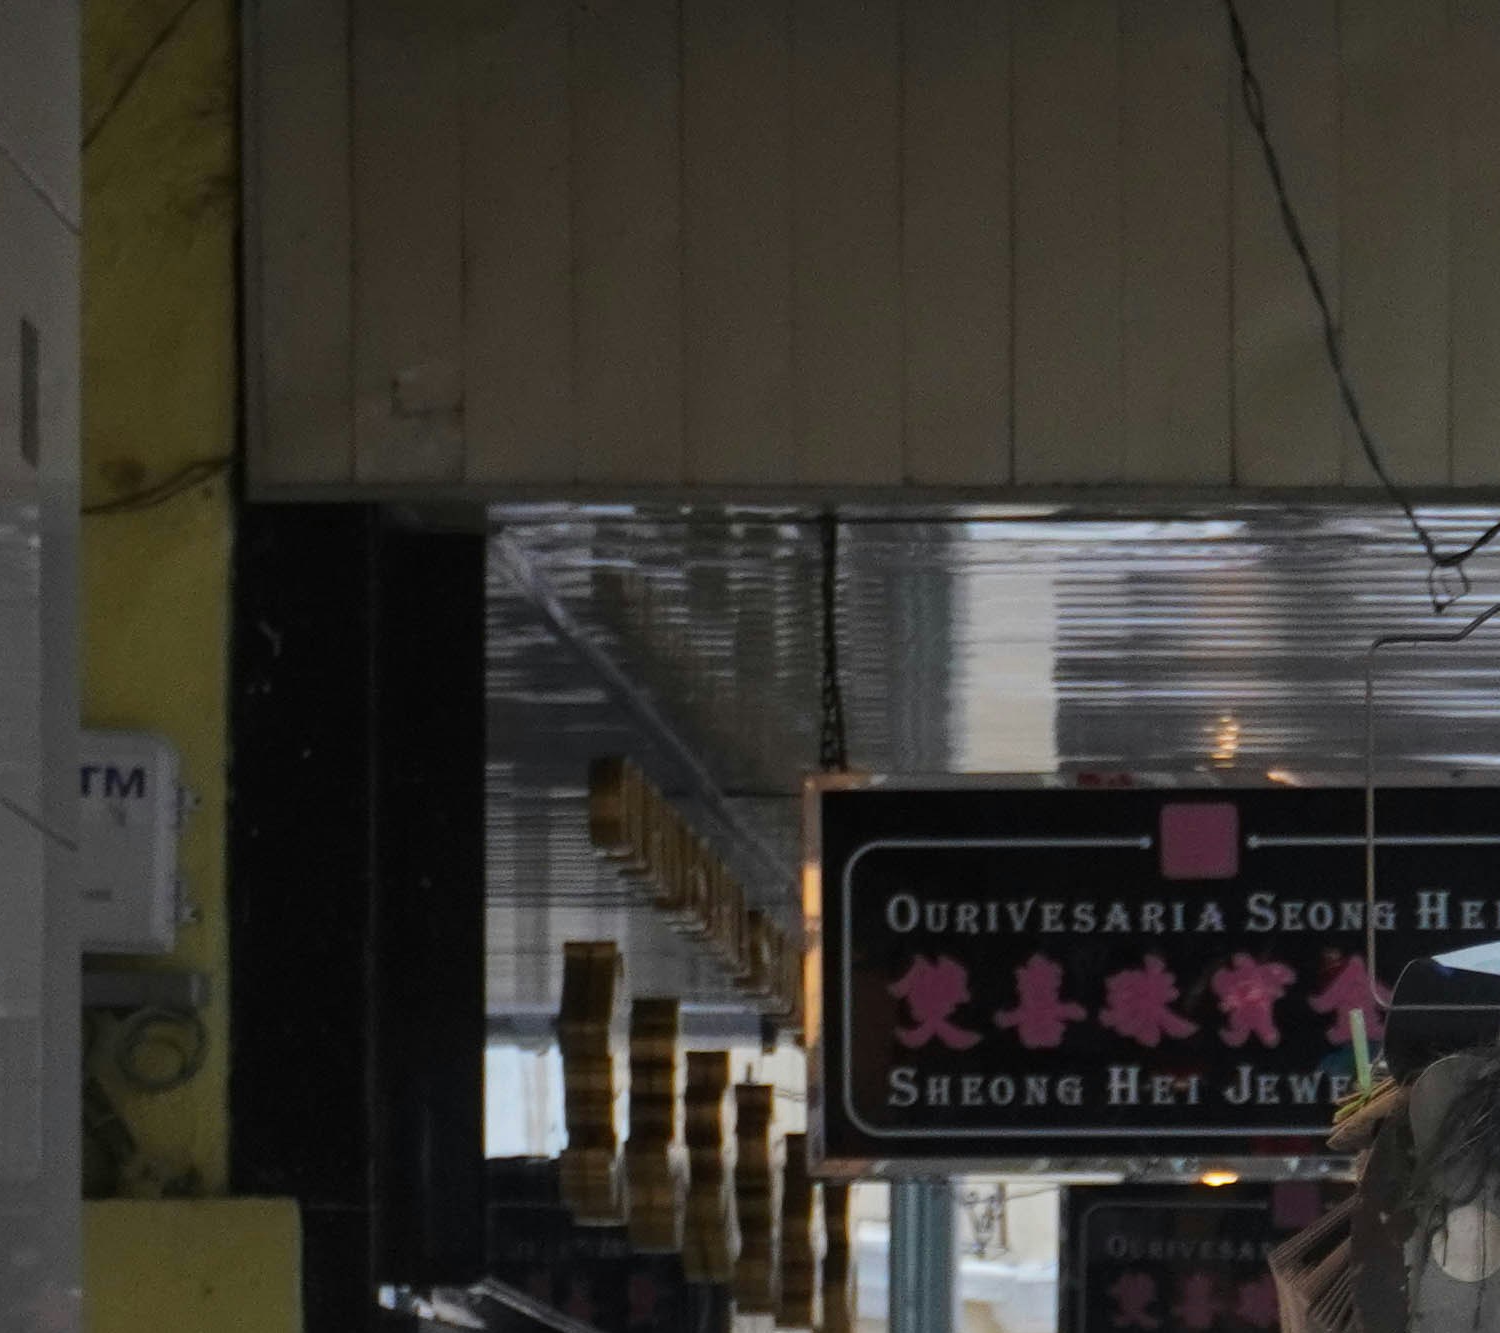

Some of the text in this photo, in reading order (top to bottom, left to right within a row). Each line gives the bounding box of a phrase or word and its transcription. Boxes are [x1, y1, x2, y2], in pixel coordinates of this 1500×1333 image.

[80, 764, 147, 798] TM
[886, 893, 1226, 935] OURIVESARIA
[1246, 892, 1397, 932] SEONG
[888, 1064, 1357, 1108] SHEONG HEI JEWE
